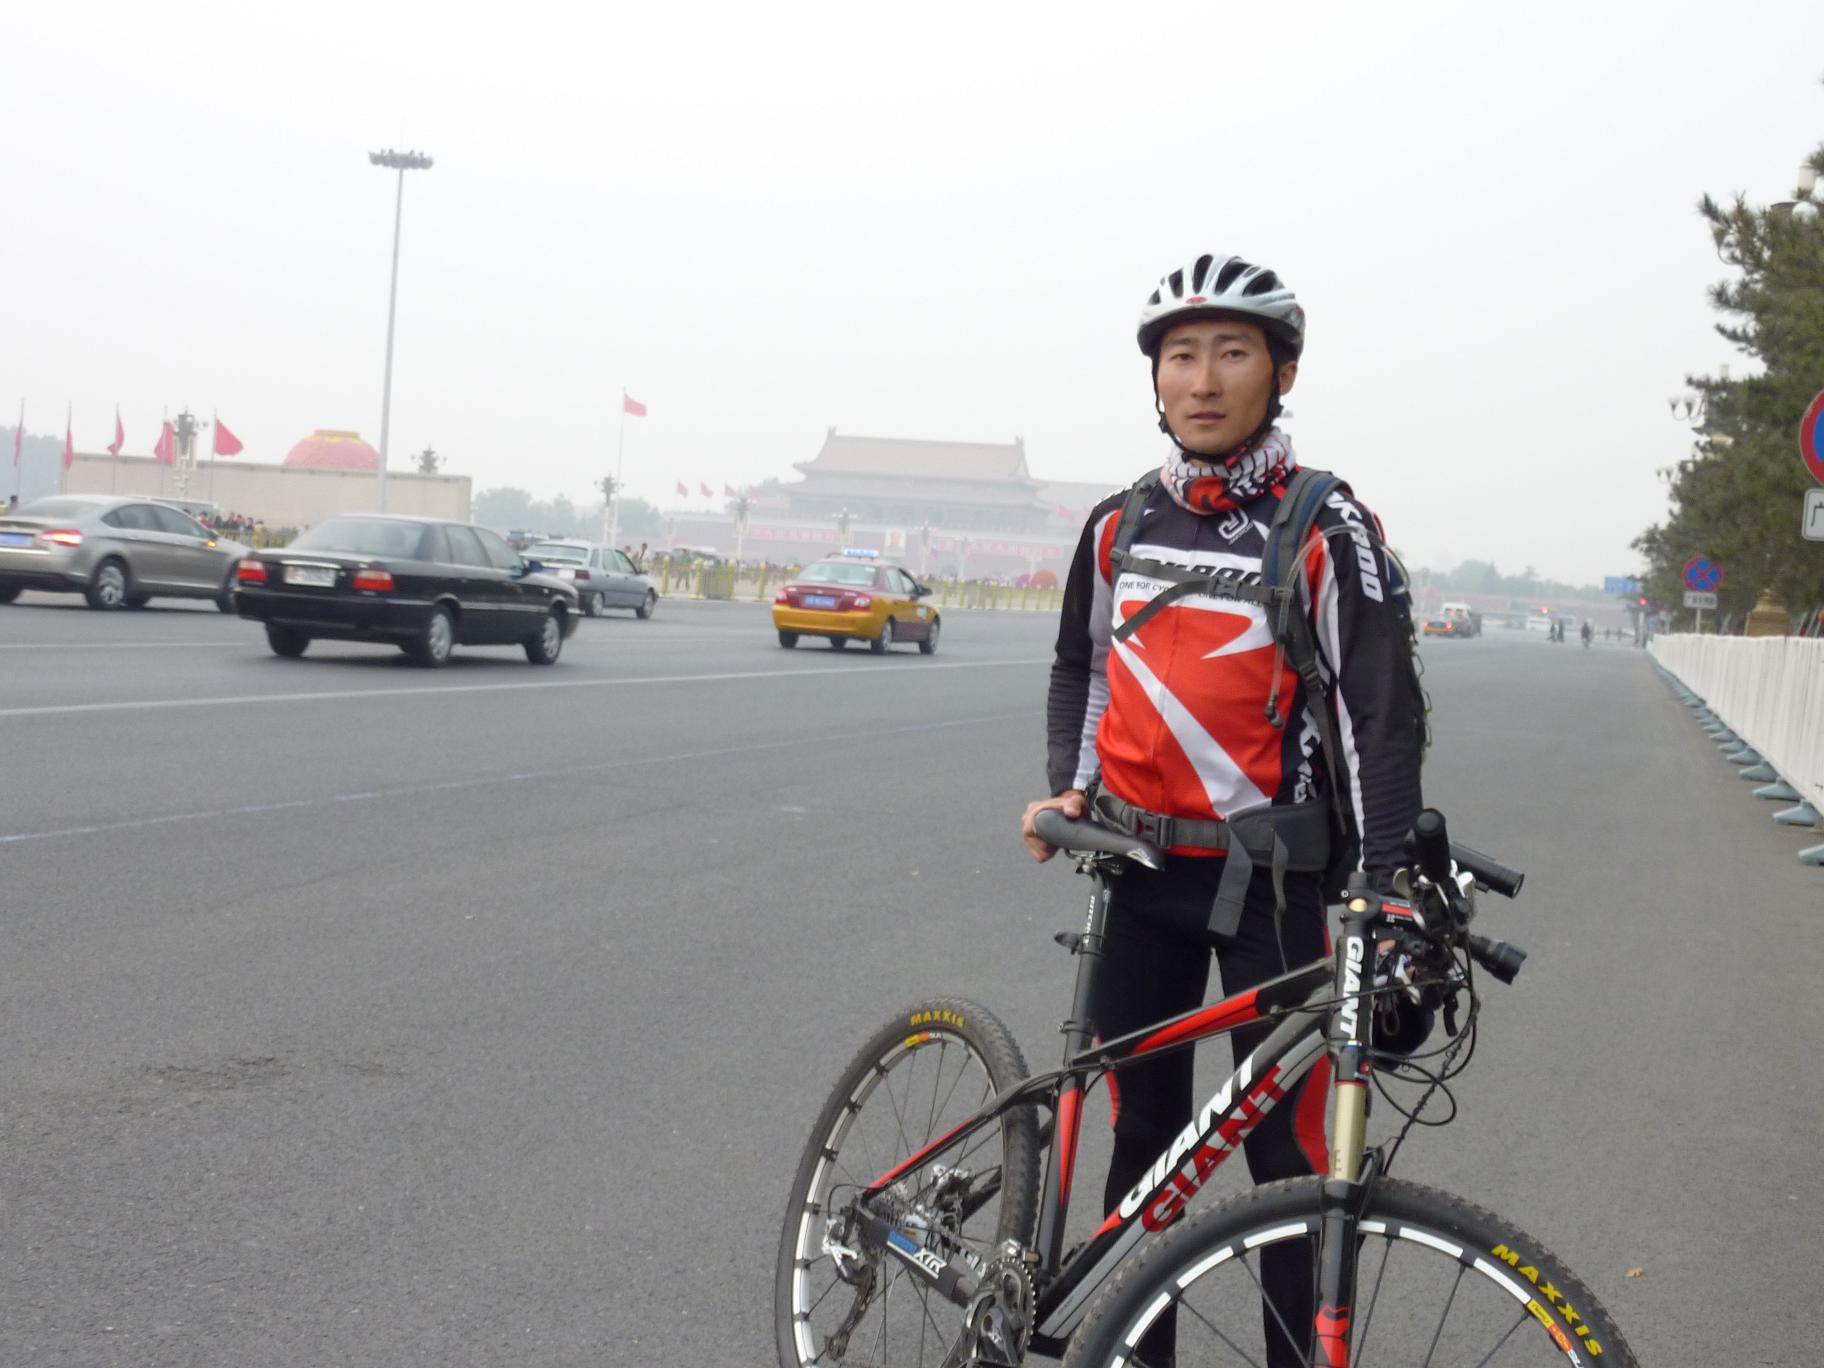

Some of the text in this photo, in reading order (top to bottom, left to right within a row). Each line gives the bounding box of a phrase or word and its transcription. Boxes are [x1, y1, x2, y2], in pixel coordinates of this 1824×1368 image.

[1137, 581, 1151, 591] FOR
[911, 1009, 966, 1031] MAXXIS
[1340, 936, 1364, 1040] GIANT
[1119, 1043, 1264, 1219] GIANT
[1142, 1064, 1286, 1232] GIANT
[913, 1247, 948, 1274] XTR
[1491, 1243, 1603, 1357] MAXXIS
